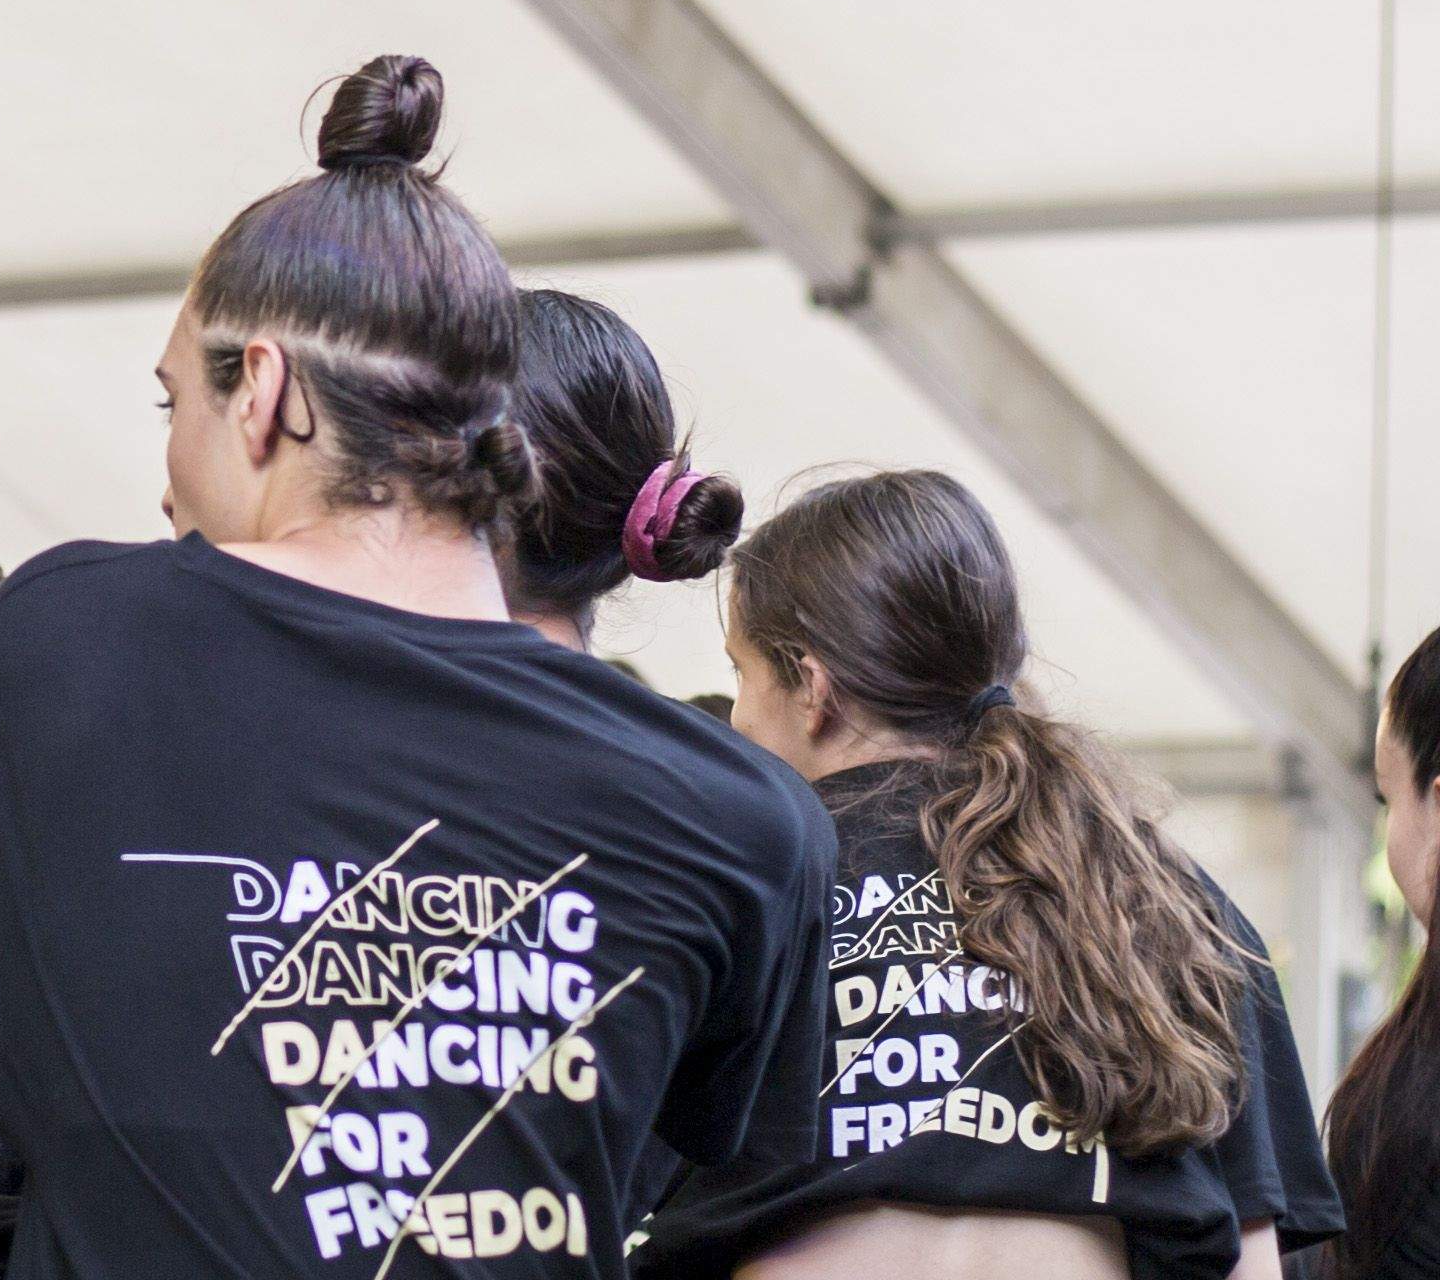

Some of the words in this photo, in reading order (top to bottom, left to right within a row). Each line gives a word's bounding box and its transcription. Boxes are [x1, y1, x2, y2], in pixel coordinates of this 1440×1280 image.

[226, 857, 598, 952] DANCING
[230, 934, 597, 1021] DANCING
[262, 1019, 598, 1102] DANCING
[834, 1033, 961, 1096] FOR
[286, 1103, 432, 1178] FOR
